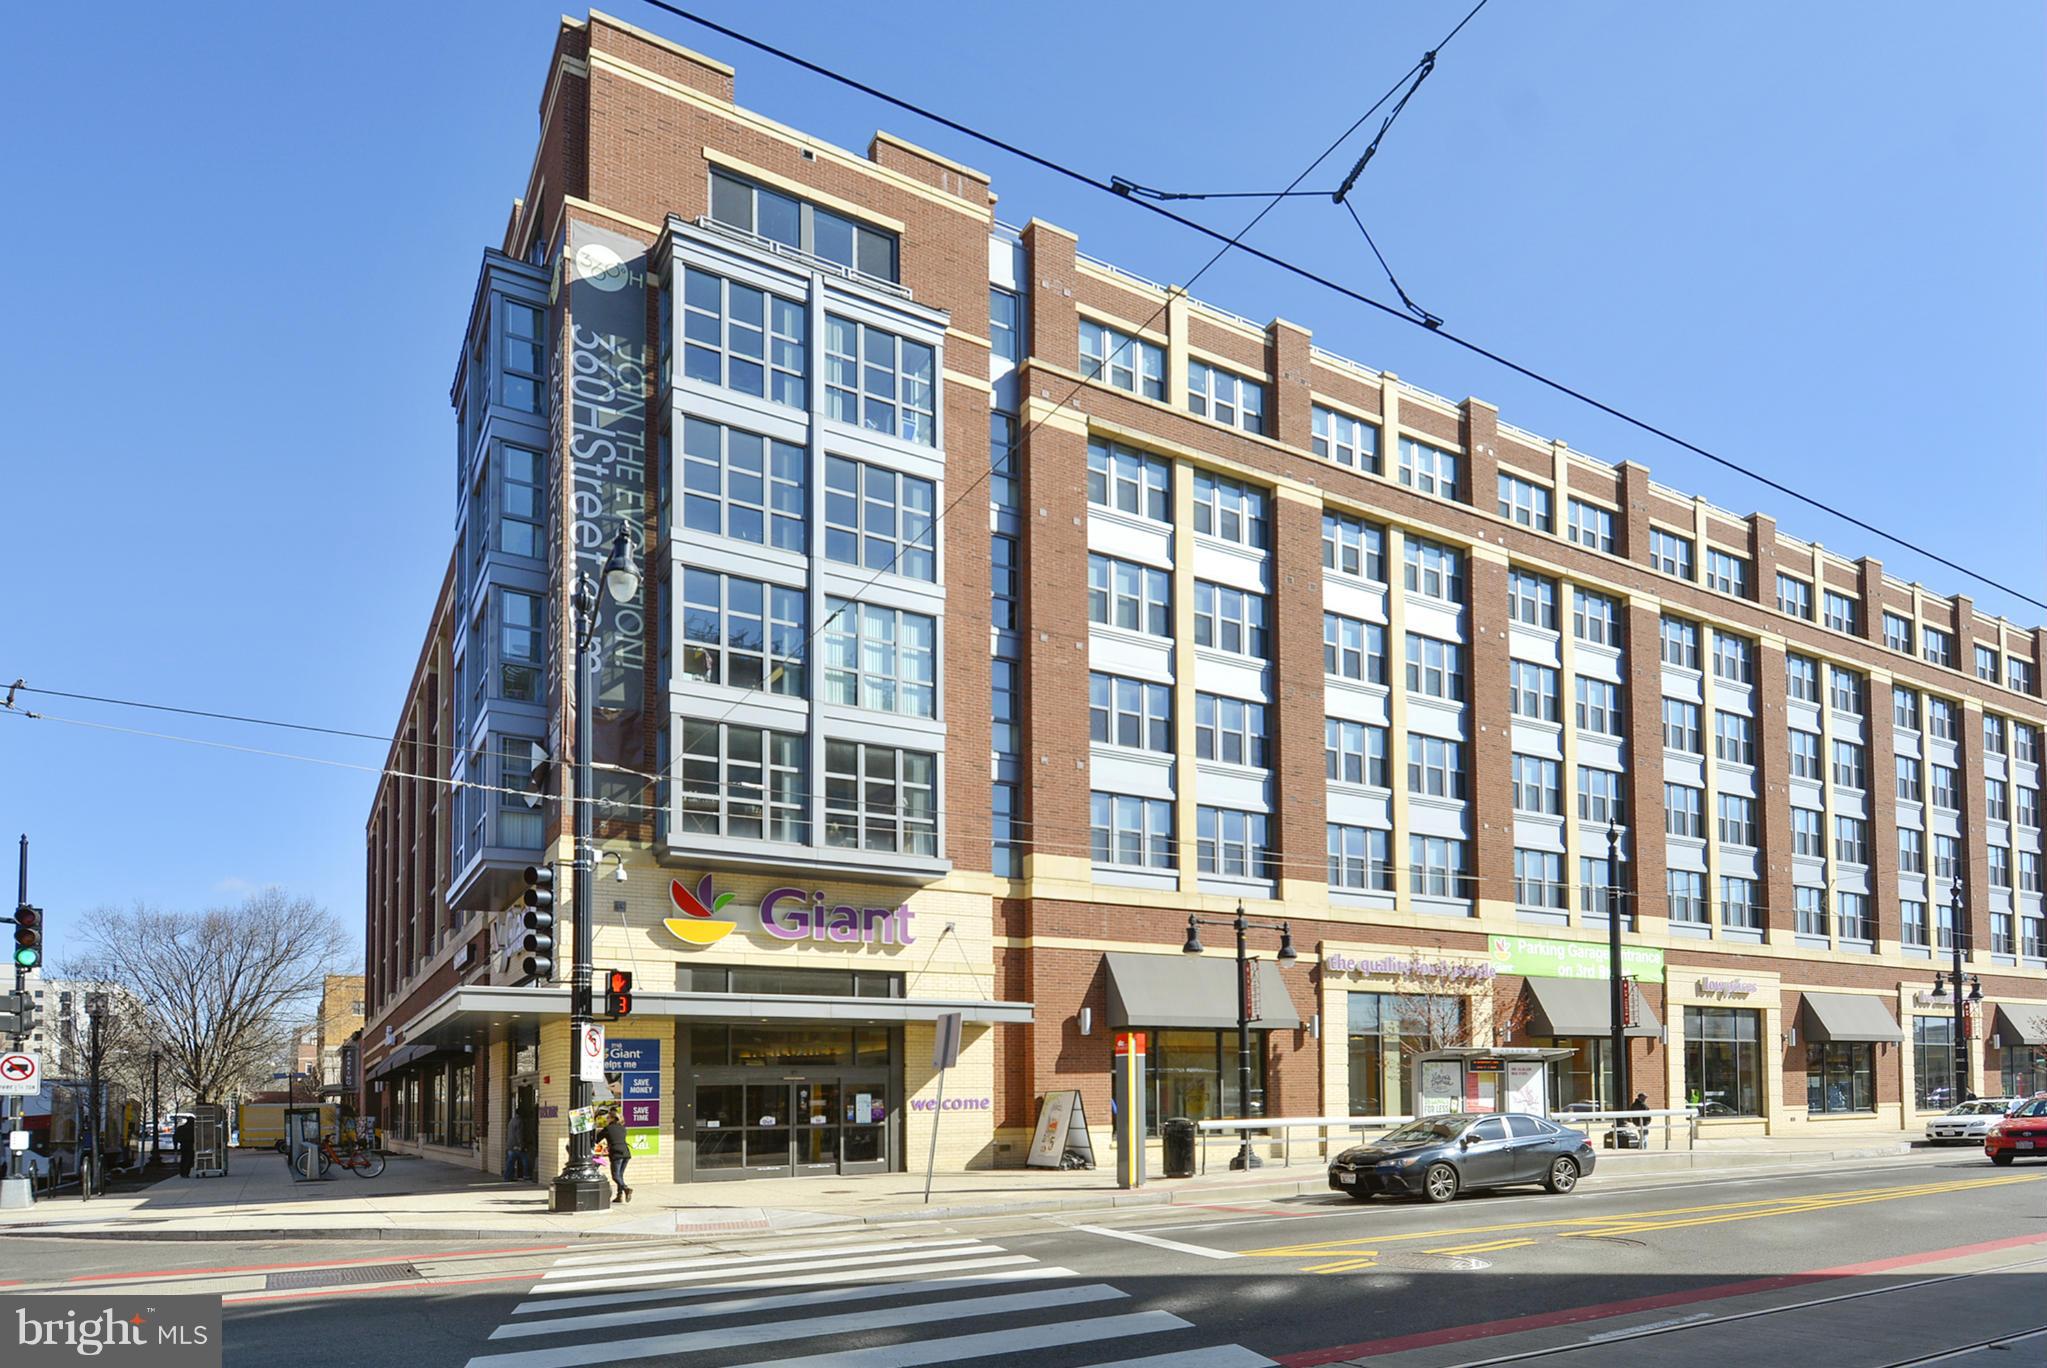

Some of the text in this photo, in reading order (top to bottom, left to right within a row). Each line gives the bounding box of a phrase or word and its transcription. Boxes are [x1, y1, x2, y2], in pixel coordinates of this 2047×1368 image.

[629, 270, 643, 288] H
[616, 347, 645, 421] JOIN
[616, 430, 645, 483] THE
[759, 887, 916, 945] Giant
[1517, 939, 1662, 964] Parking Garage ntrance
[1328, 954, 1355, 971] the
[1360, 957, 1412, 976] quality
[1558, 966, 1572, 976] on
[1576, 965, 1597, 977] 3rd
[619, 996, 627, 1014] 3
[610, 1048, 642, 1059] Giant
[604, 1060, 623, 1070] elps
[624, 1061, 637, 1069] me
[633, 1079, 650, 1087] SAVE
[629, 1086, 653, 1094] MONEY
[633, 1106, 649, 1114] SAVE
[911, 1098, 990, 1111] wecome
[1424, 1104, 1449, 1114] FOR LESS
[633, 1114, 649, 1122] TIME
